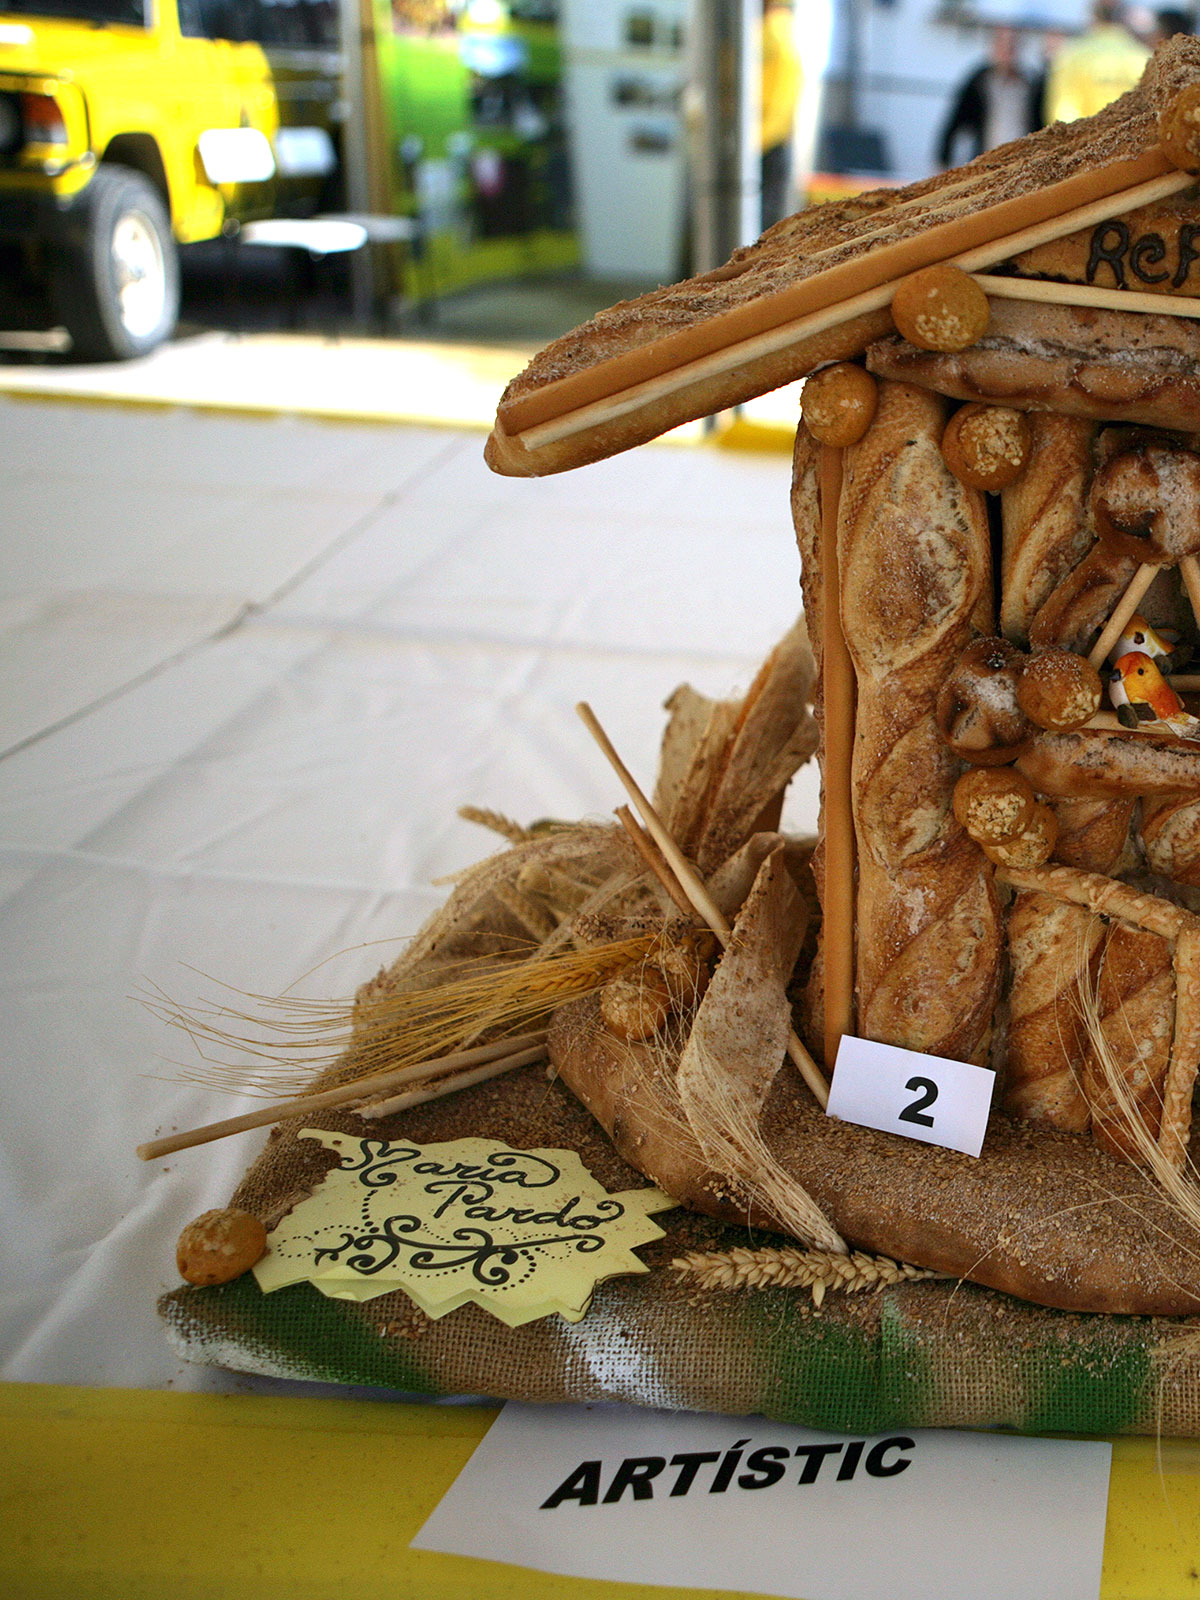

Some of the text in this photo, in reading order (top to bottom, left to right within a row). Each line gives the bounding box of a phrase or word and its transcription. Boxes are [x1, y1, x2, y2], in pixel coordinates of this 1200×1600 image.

[898, 1076, 939, 1128] 2
[424, 1180, 625, 1230] Pardo
[538, 1436, 916, 1510] ARTÍSTIC
